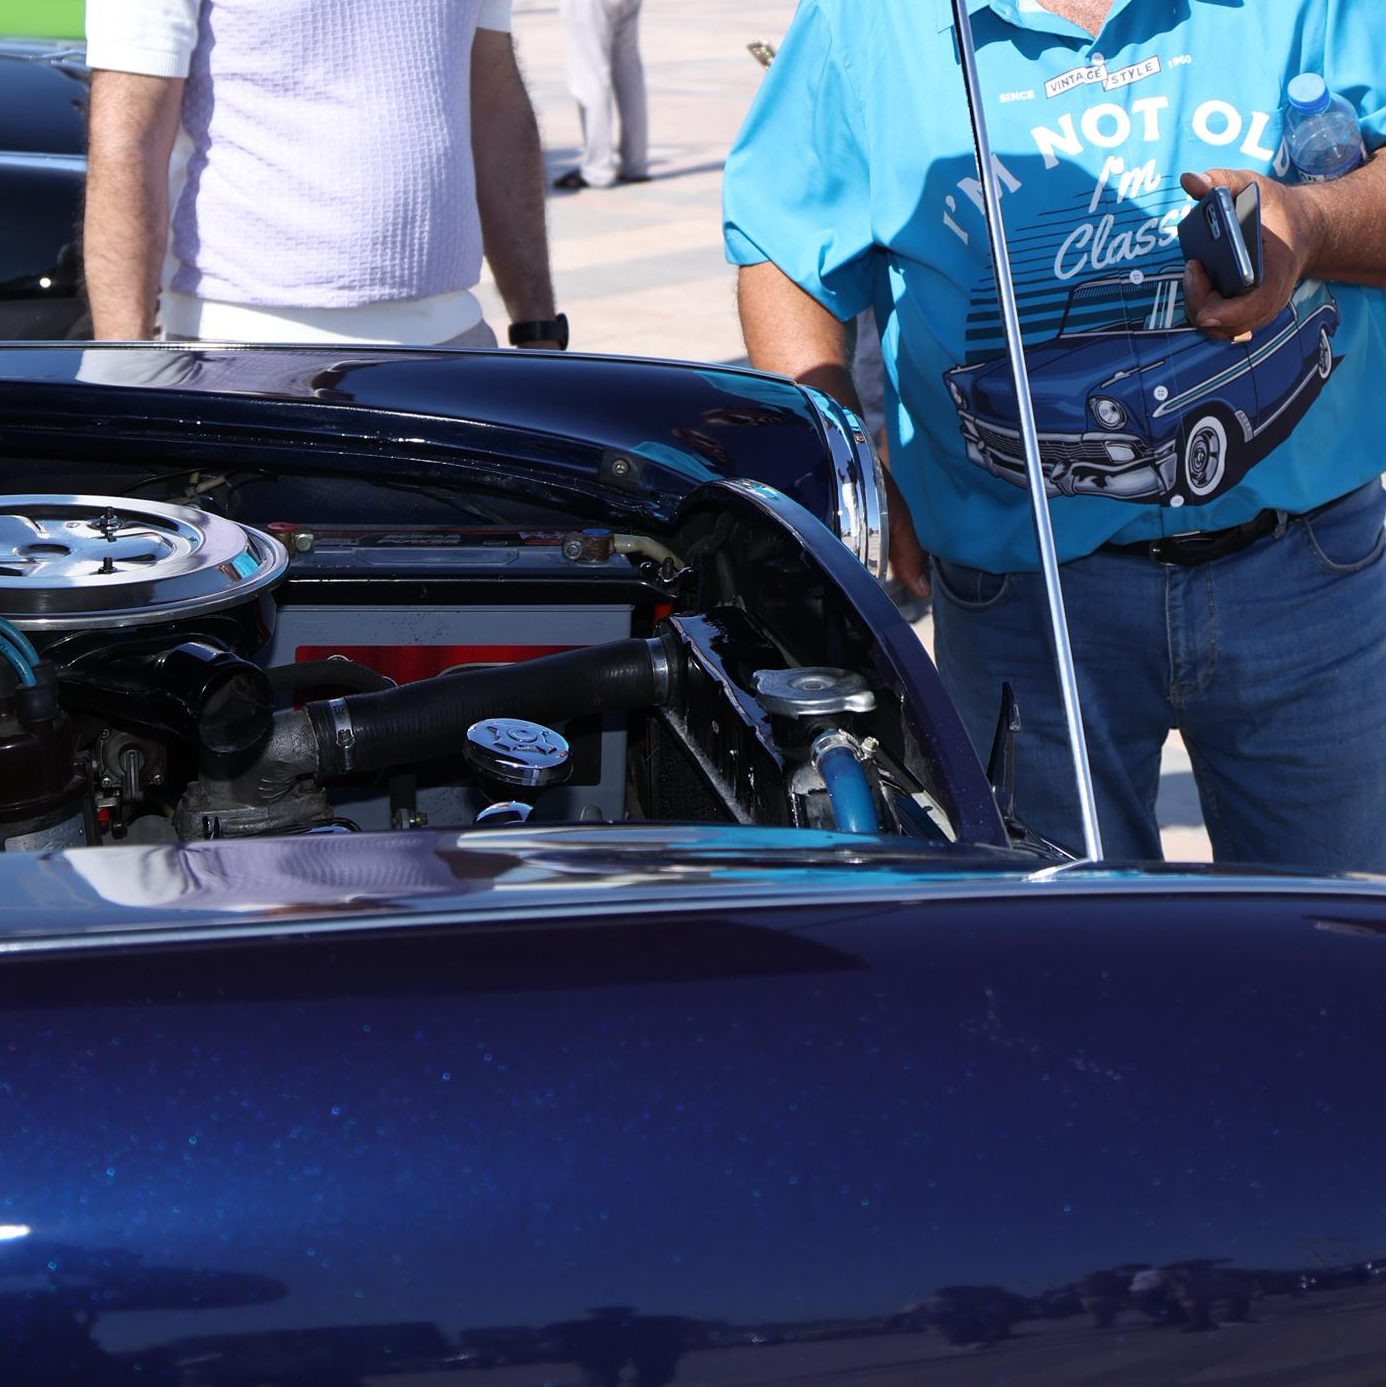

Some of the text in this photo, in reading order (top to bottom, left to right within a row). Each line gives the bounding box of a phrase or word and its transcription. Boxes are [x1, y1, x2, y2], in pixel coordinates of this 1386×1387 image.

[999, 89, 1036, 103] SINCE
[1049, 67, 1103, 93] VINTAGE
[1112, 61, 1154, 85] STYLE
[1030, 96, 1170, 170] NOT
[1088, 155, 1162, 214] I'm
